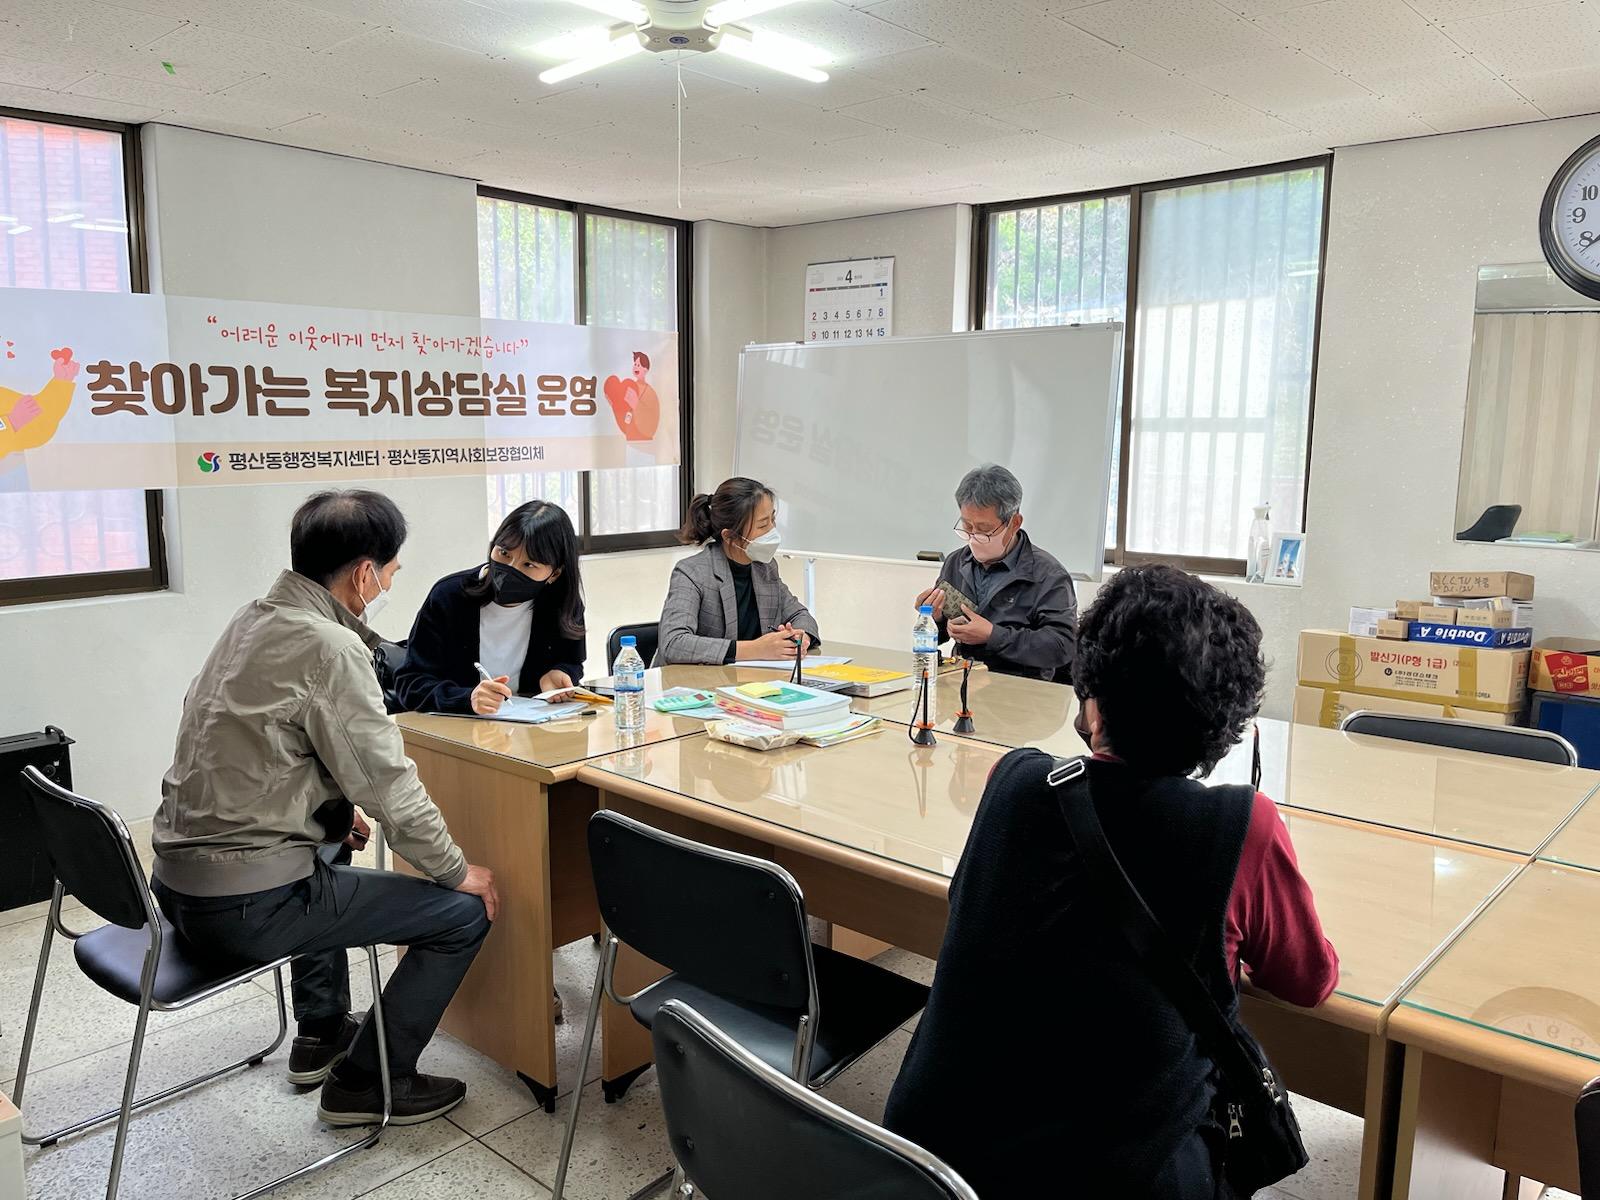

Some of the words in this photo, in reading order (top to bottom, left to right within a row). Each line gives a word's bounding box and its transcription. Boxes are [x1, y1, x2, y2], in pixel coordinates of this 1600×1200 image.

[1582, 185, 1599, 201] 10
[1572, 207, 1586, 223] 9
[1579, 231, 1593, 248] 8
[845, 270, 853, 283] 4
[879, 288, 884, 296] 1
[812, 312, 817, 321] 2
[823, 312, 828, 320] 3
[834, 311, 839, 319] 4
[845, 310, 851, 319] 5
[856, 310, 862, 318] 6
[867, 309, 872, 317] 7
[878, 308, 884, 317] 8
[289, 326, 363, 351] 이웃에게
[371, 332, 404, 352] 먼저
[811, 331, 817, 340] 9
[821, 331, 829, 339] 10
[833, 330, 840, 339] 11
[844, 330, 852, 338] 12
[855, 329, 863, 338] 13
[866, 329, 873, 337] 14
[876, 328, 885, 337] 15
[86, 360, 311, 418] 찾아가는
[325, 367, 528, 418] 복지상담실
[536, 374, 598, 416] 운영
[1420, 626, 1431, 636] A
[1435, 627, 1487, 642] Double
[1370, 651, 1421, 667] 발신기(P형
[1427, 658, 1447, 669] 1급)
